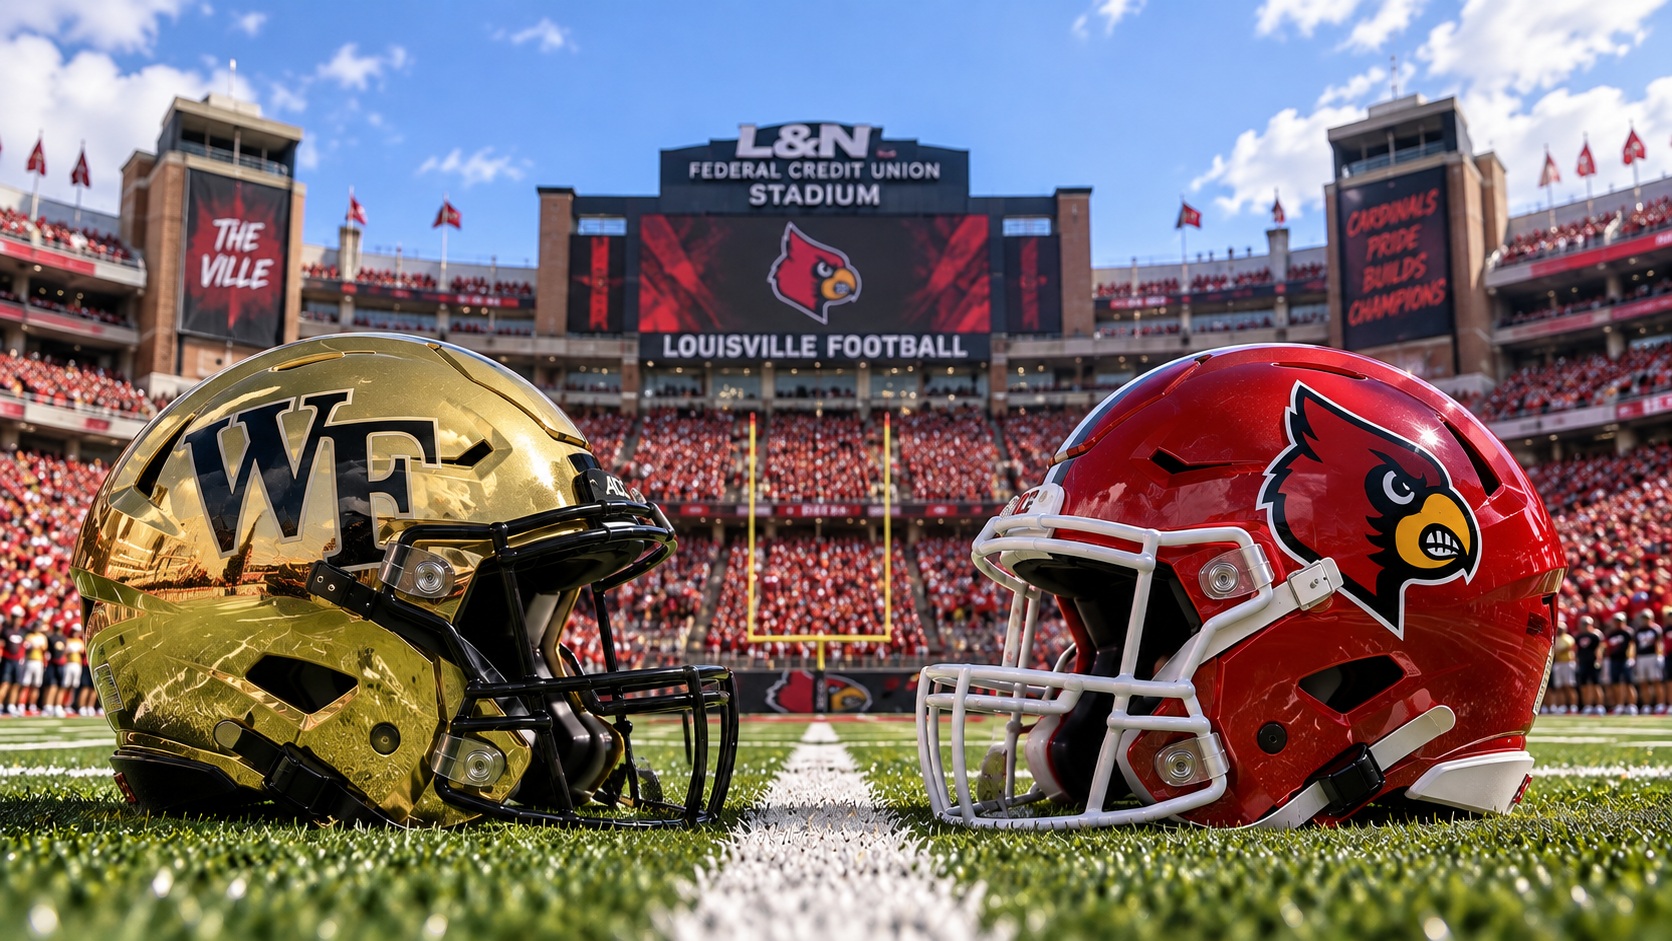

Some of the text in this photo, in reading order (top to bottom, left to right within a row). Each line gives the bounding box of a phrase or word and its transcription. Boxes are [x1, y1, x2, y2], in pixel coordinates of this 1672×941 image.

[735, 124, 872, 159] L&N
[689, 161, 940, 179] FEDERAL CREDIT UNION
[749, 183, 880, 206] STADIUM
[1346, 188, 1440, 237] CARDINALS
[212, 218, 265, 252] THE
[1366, 224, 1422, 262] PRIDE
[201, 253, 274, 290] VILLE
[1362, 252, 1428, 293] BUILDS
[1348, 278, 1446, 327] CHAMPIONS
[662, 334, 968, 358] LOUISVILLE FOOTBALL
[182, 389, 441, 570] WF
